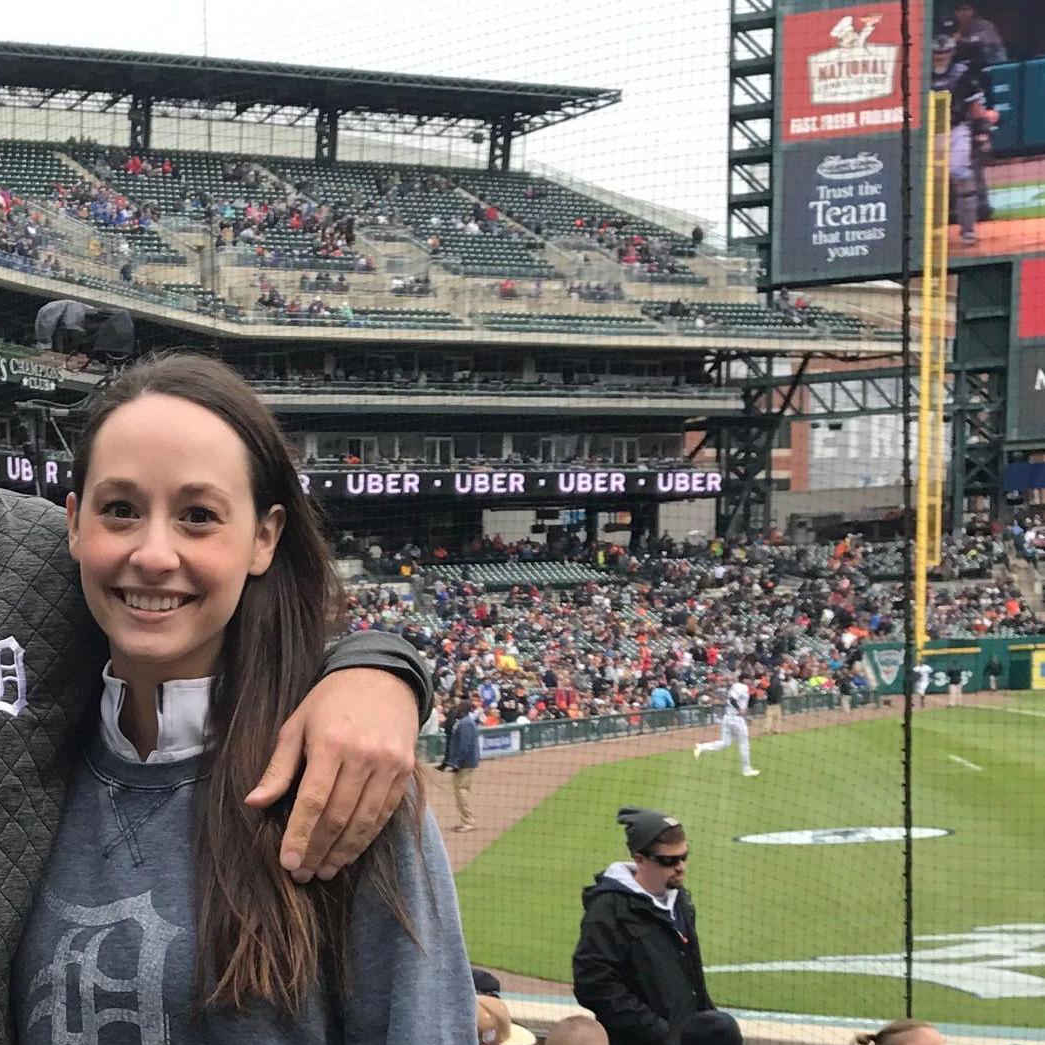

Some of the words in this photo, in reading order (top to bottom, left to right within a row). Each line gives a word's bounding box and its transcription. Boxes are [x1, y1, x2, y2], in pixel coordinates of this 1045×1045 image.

[816, 184, 854, 200] Trust
[857, 181, 883, 196] the
[808, 200, 888, 227] Team
[812, 230, 841, 245] that
[845, 227, 886, 241] treats
[826, 245, 870, 262] yours
[6, 455, 59, 484] UBR
[346, 473, 420, 495] UBER
[455, 473, 525, 493] UBER
[558, 472, 627, 492] UBER
[657, 472, 723, 492] UBER
